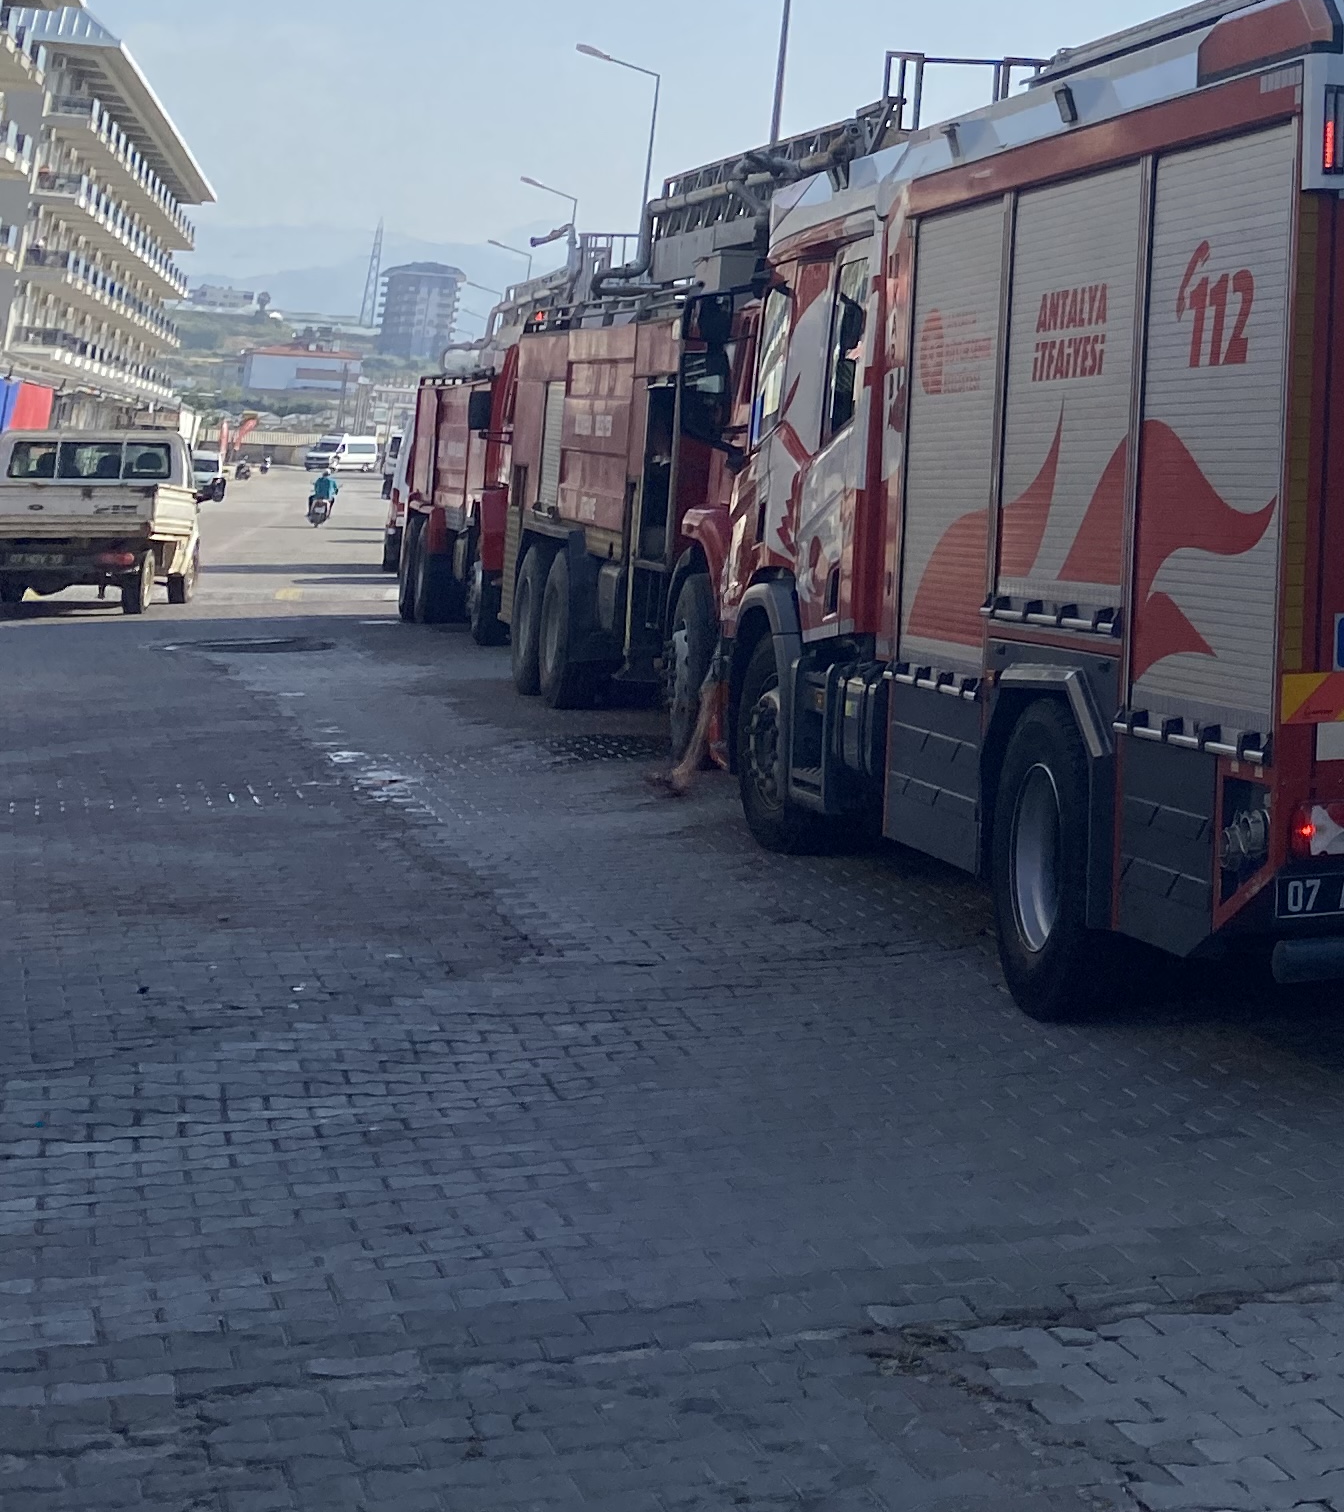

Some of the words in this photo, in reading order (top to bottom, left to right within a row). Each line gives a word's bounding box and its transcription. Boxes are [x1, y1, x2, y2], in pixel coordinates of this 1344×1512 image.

[1036, 283, 1107, 333] ANTALYA
[1188, 269, 1254, 368] 112
[1032, 334, 1106, 382] İTFAİYESİ
[1287, 879, 1321, 912] 07
